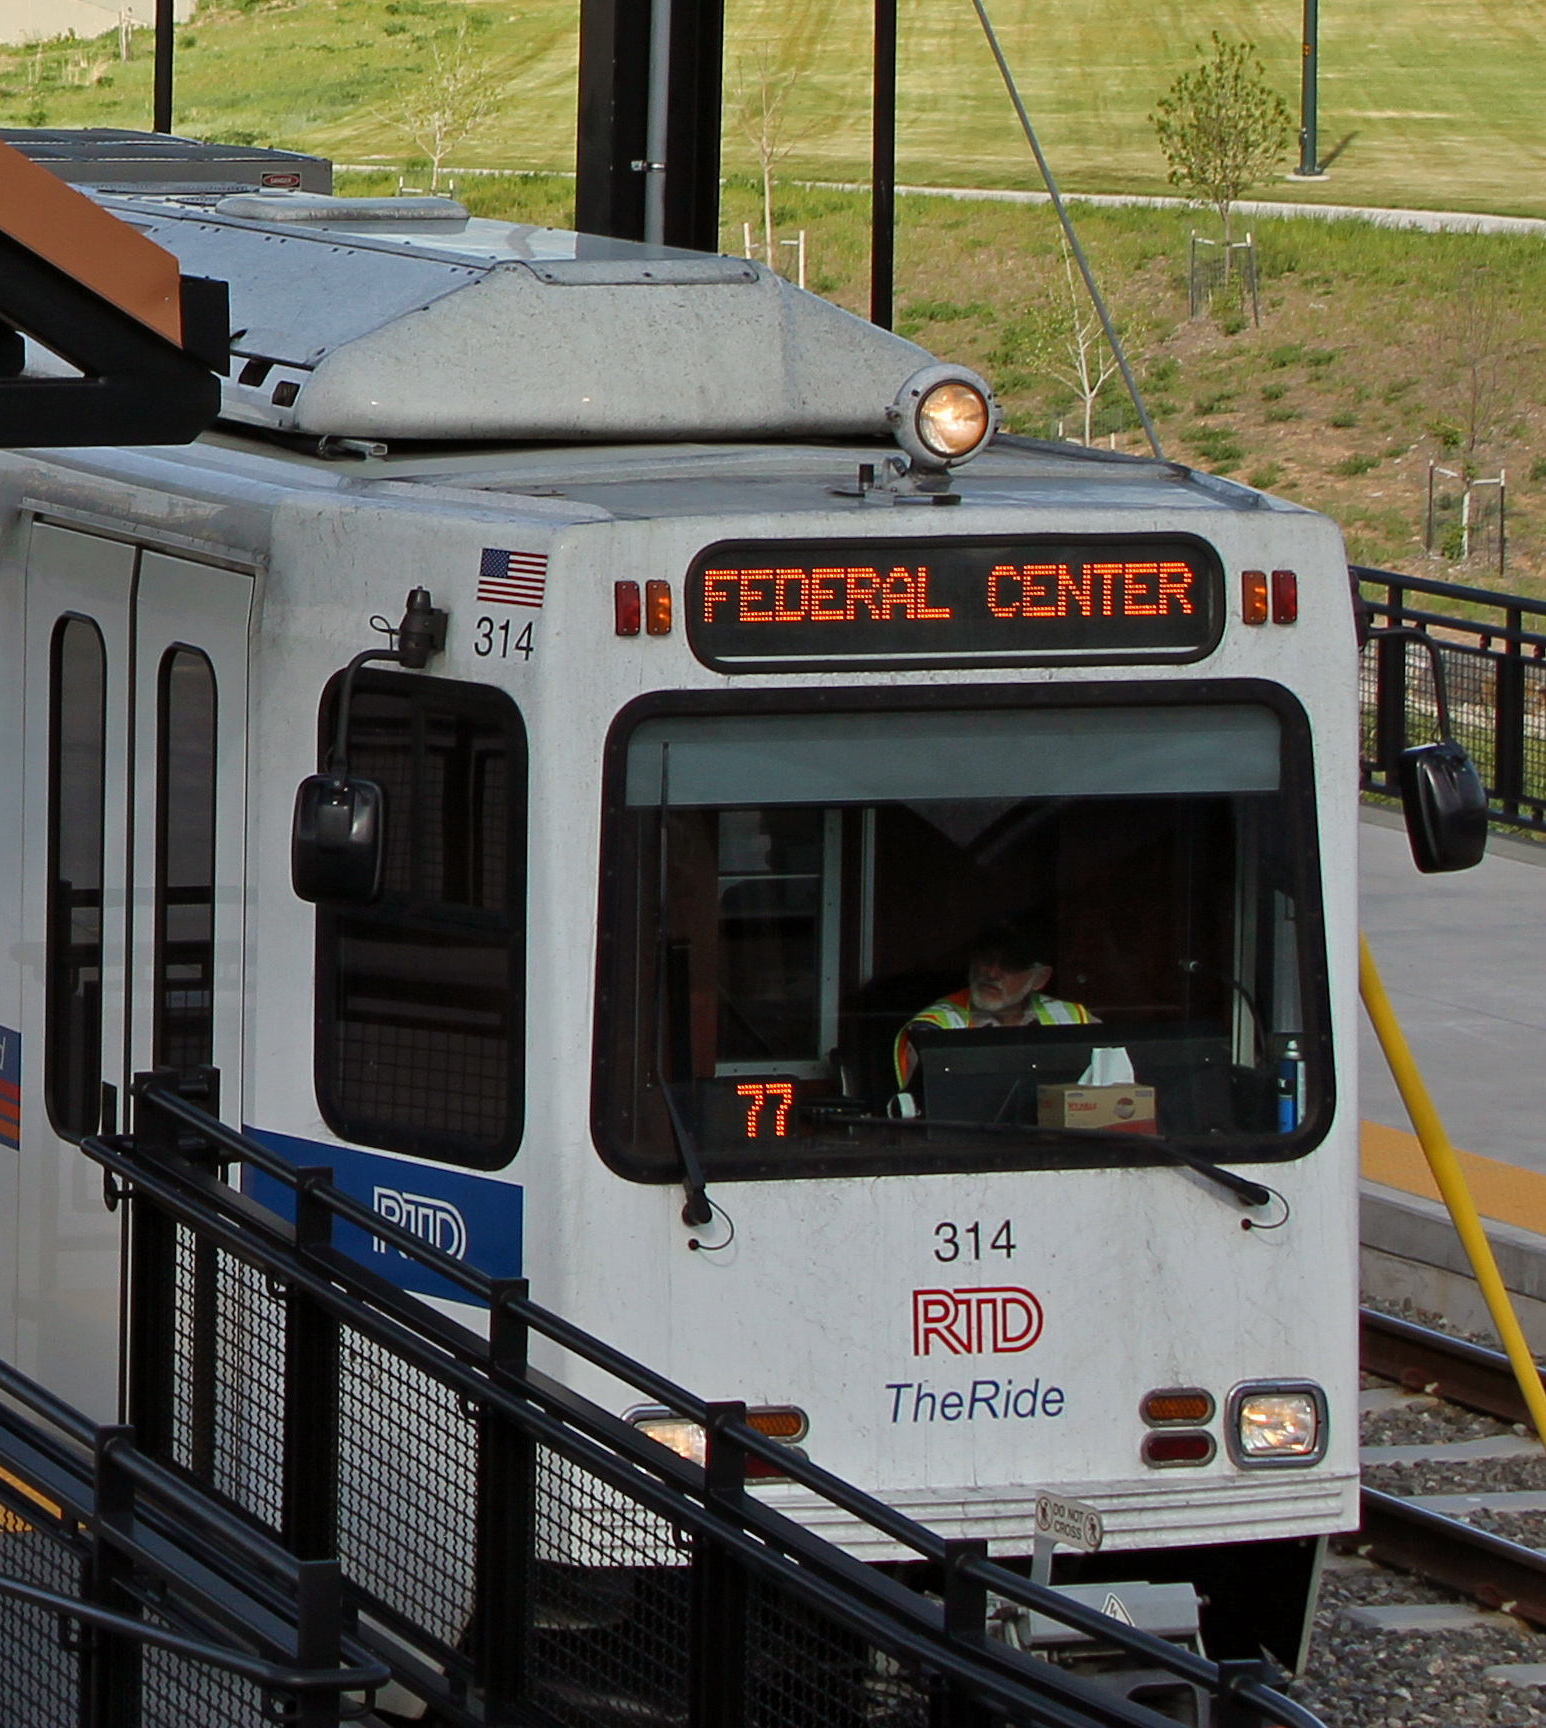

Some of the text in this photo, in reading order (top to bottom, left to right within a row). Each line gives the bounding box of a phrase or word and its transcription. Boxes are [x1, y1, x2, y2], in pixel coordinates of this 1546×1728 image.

[703, 561, 1194, 623] FEDERAL CENTER
[474, 615, 534, 661] 314
[736, 1083, 792, 1139] 77
[933, 1219, 1017, 1263] 314
[912, 1286, 1044, 1357] RTD
[884, 1377, 1066, 1424] TheRide
[1052, 1502, 1084, 1524] DO NOT
[1053, 1520, 1082, 1540] CROSS
